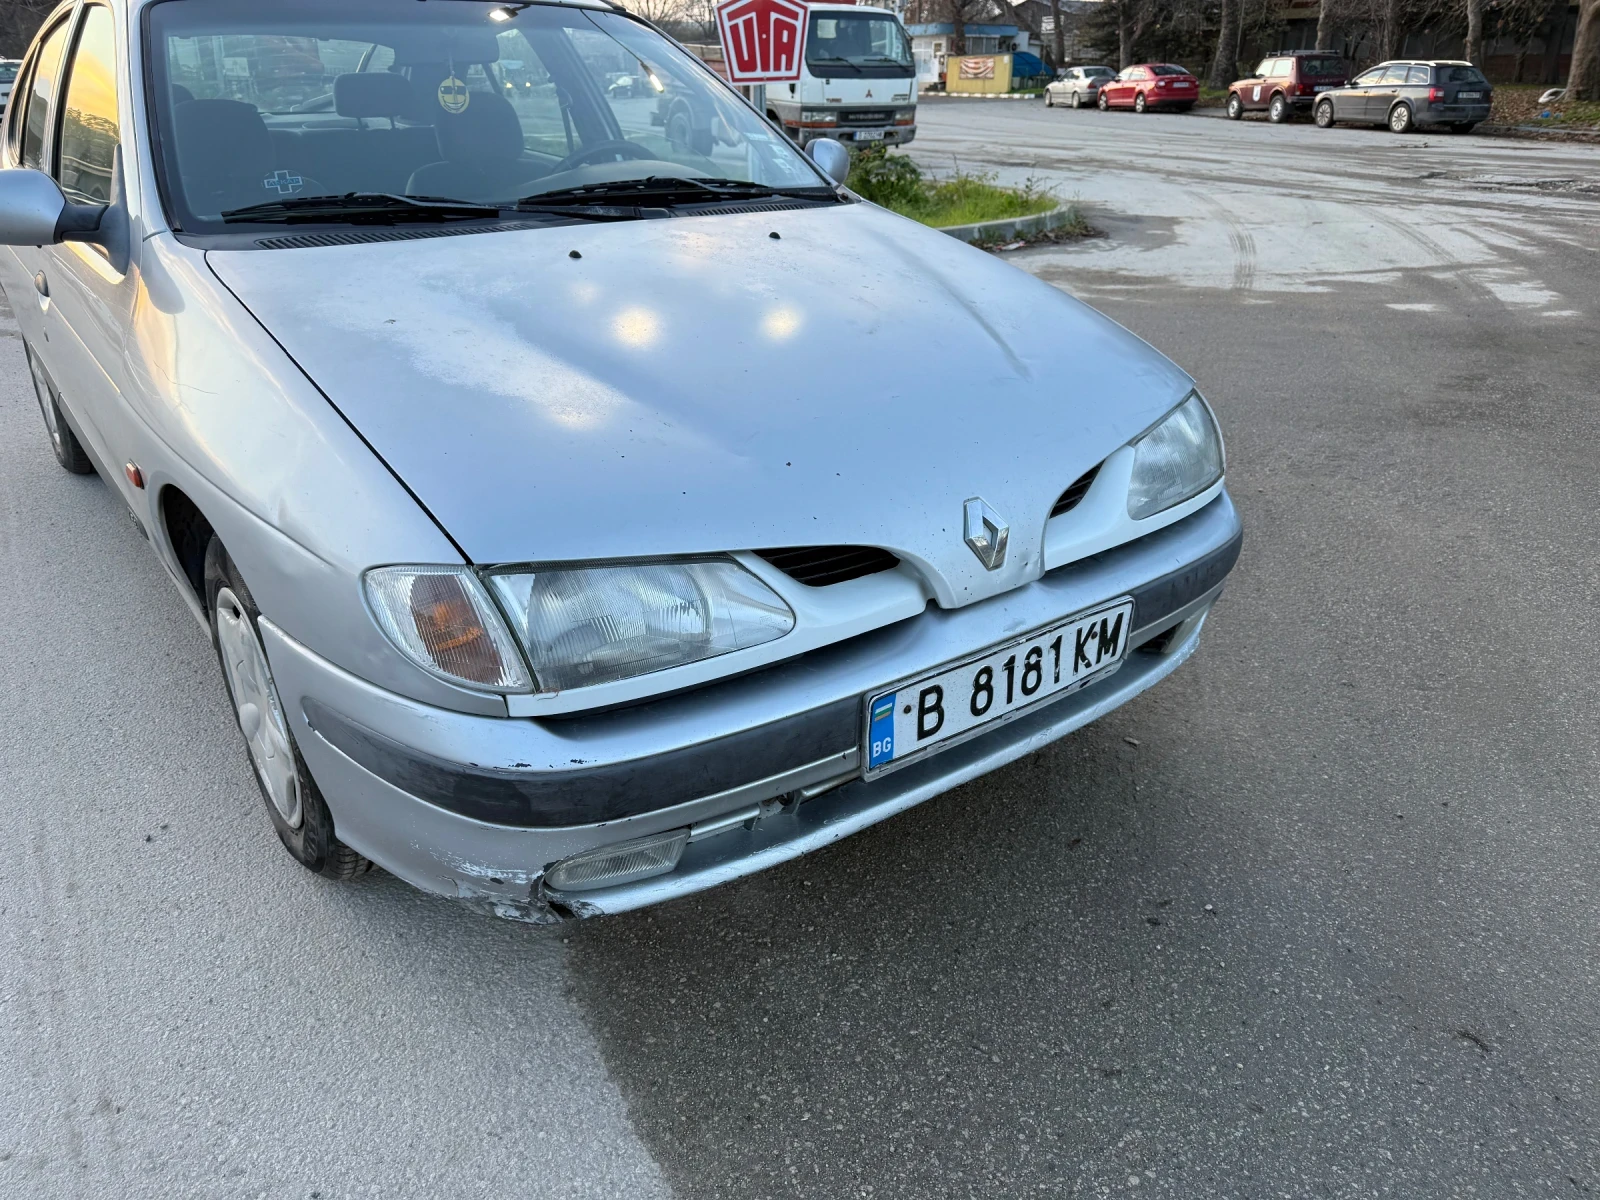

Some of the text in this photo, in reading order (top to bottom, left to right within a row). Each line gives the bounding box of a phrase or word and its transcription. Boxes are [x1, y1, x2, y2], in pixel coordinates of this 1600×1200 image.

[917, 611, 1125, 741] B 8181 KM
[872, 736, 892, 759] BG
